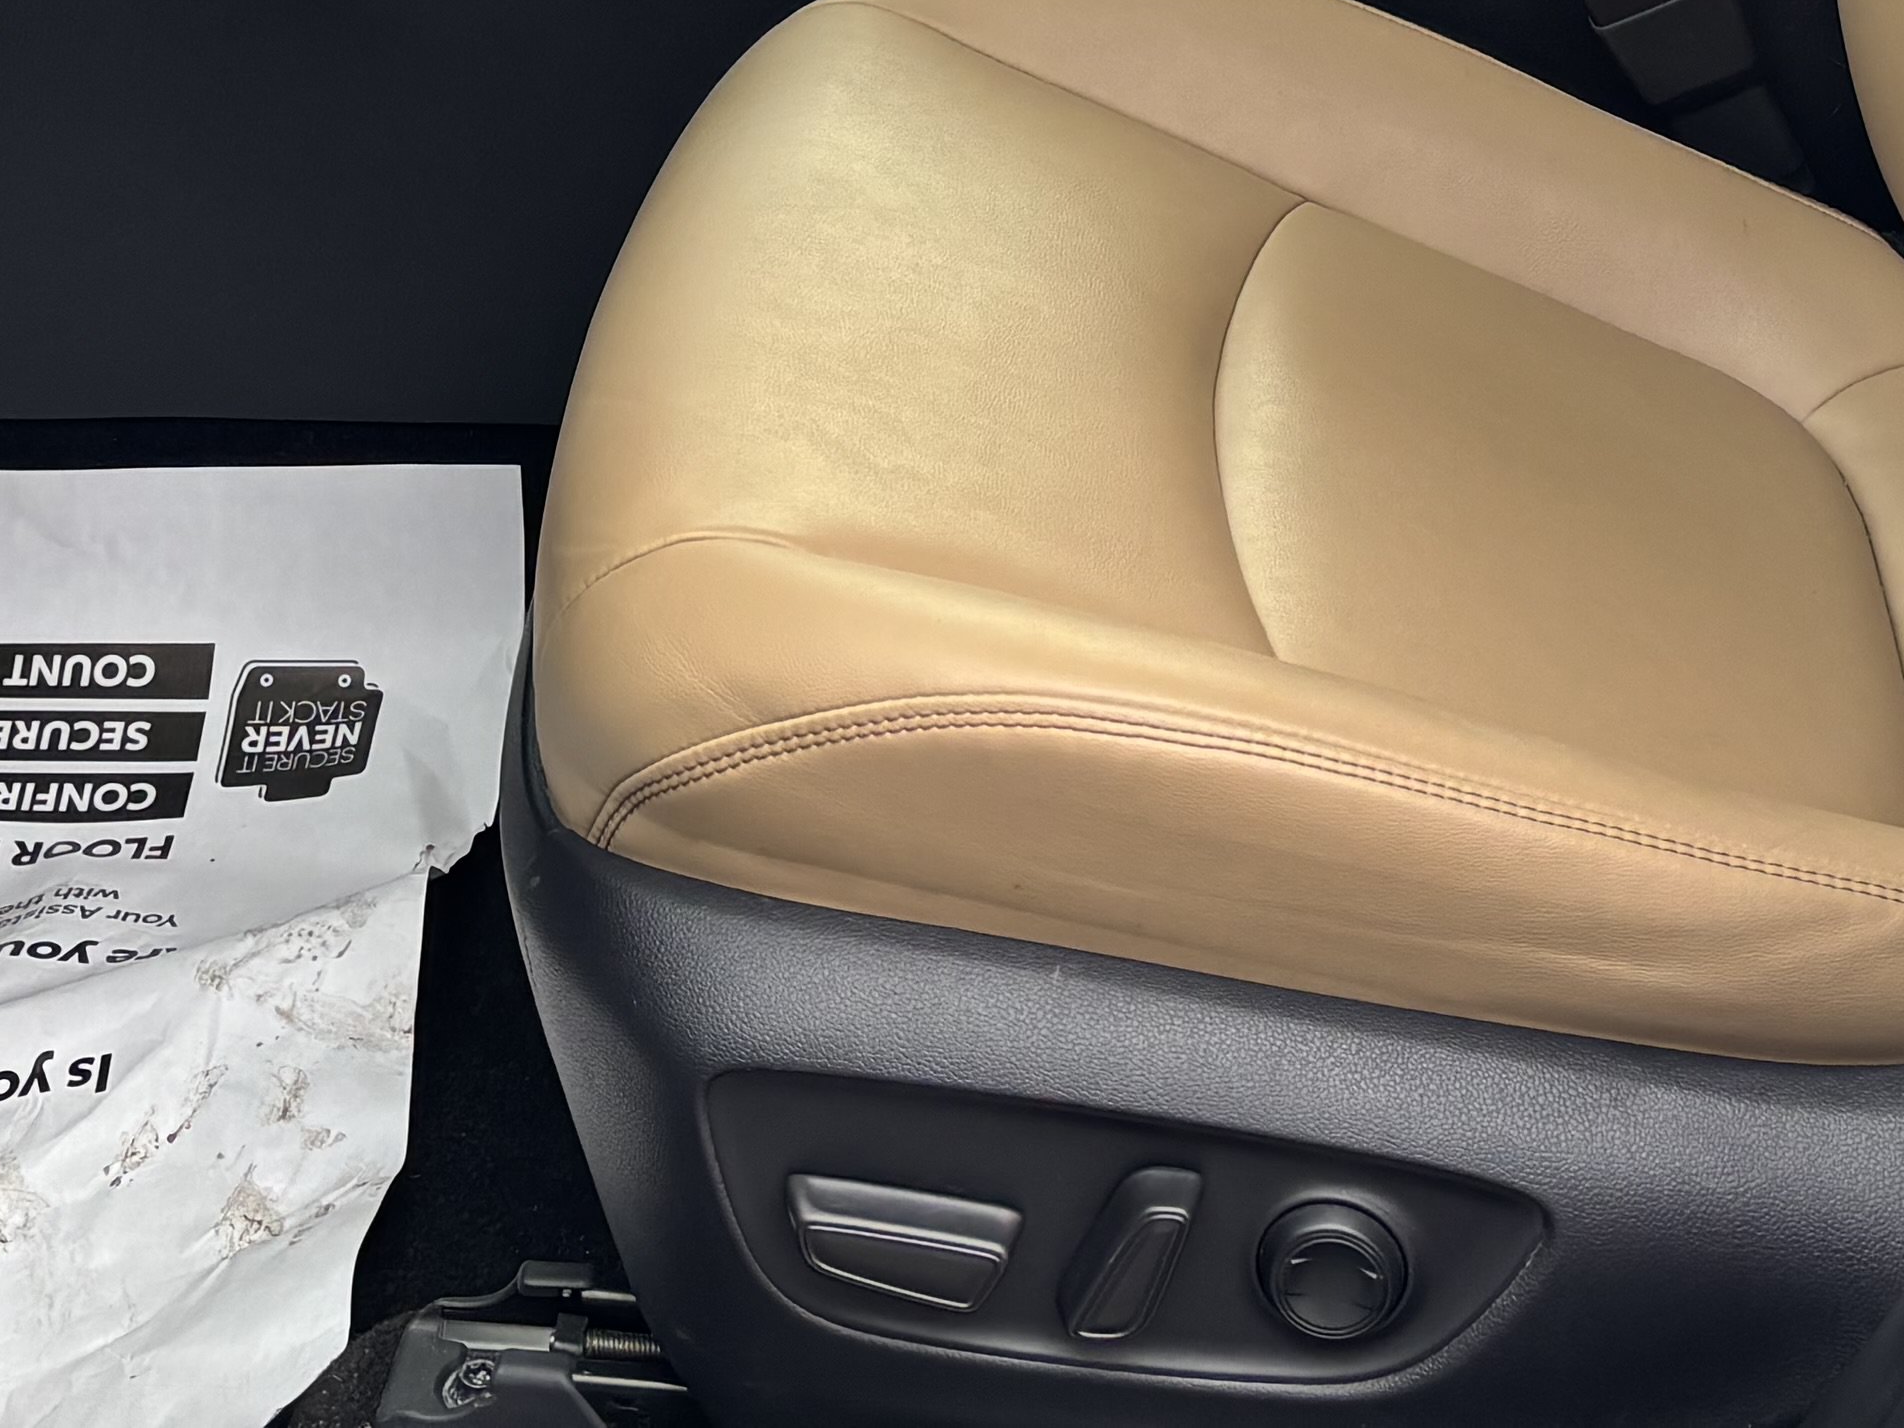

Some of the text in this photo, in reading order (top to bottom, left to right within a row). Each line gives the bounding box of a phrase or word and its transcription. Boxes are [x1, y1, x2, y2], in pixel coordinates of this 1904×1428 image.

[2, 653, 157, 689] COUNT
[246, 699, 368, 725] STACK IT
[239, 721, 364, 753] NEVER
[235, 744, 356, 774] SECURE IT
[10, 834, 175, 867] FLOOR
[52, 885, 120, 901] with
[105, 909, 178, 928] Your
[105, 947, 178, 965] re
[67, 1053, 113, 1095] Is
